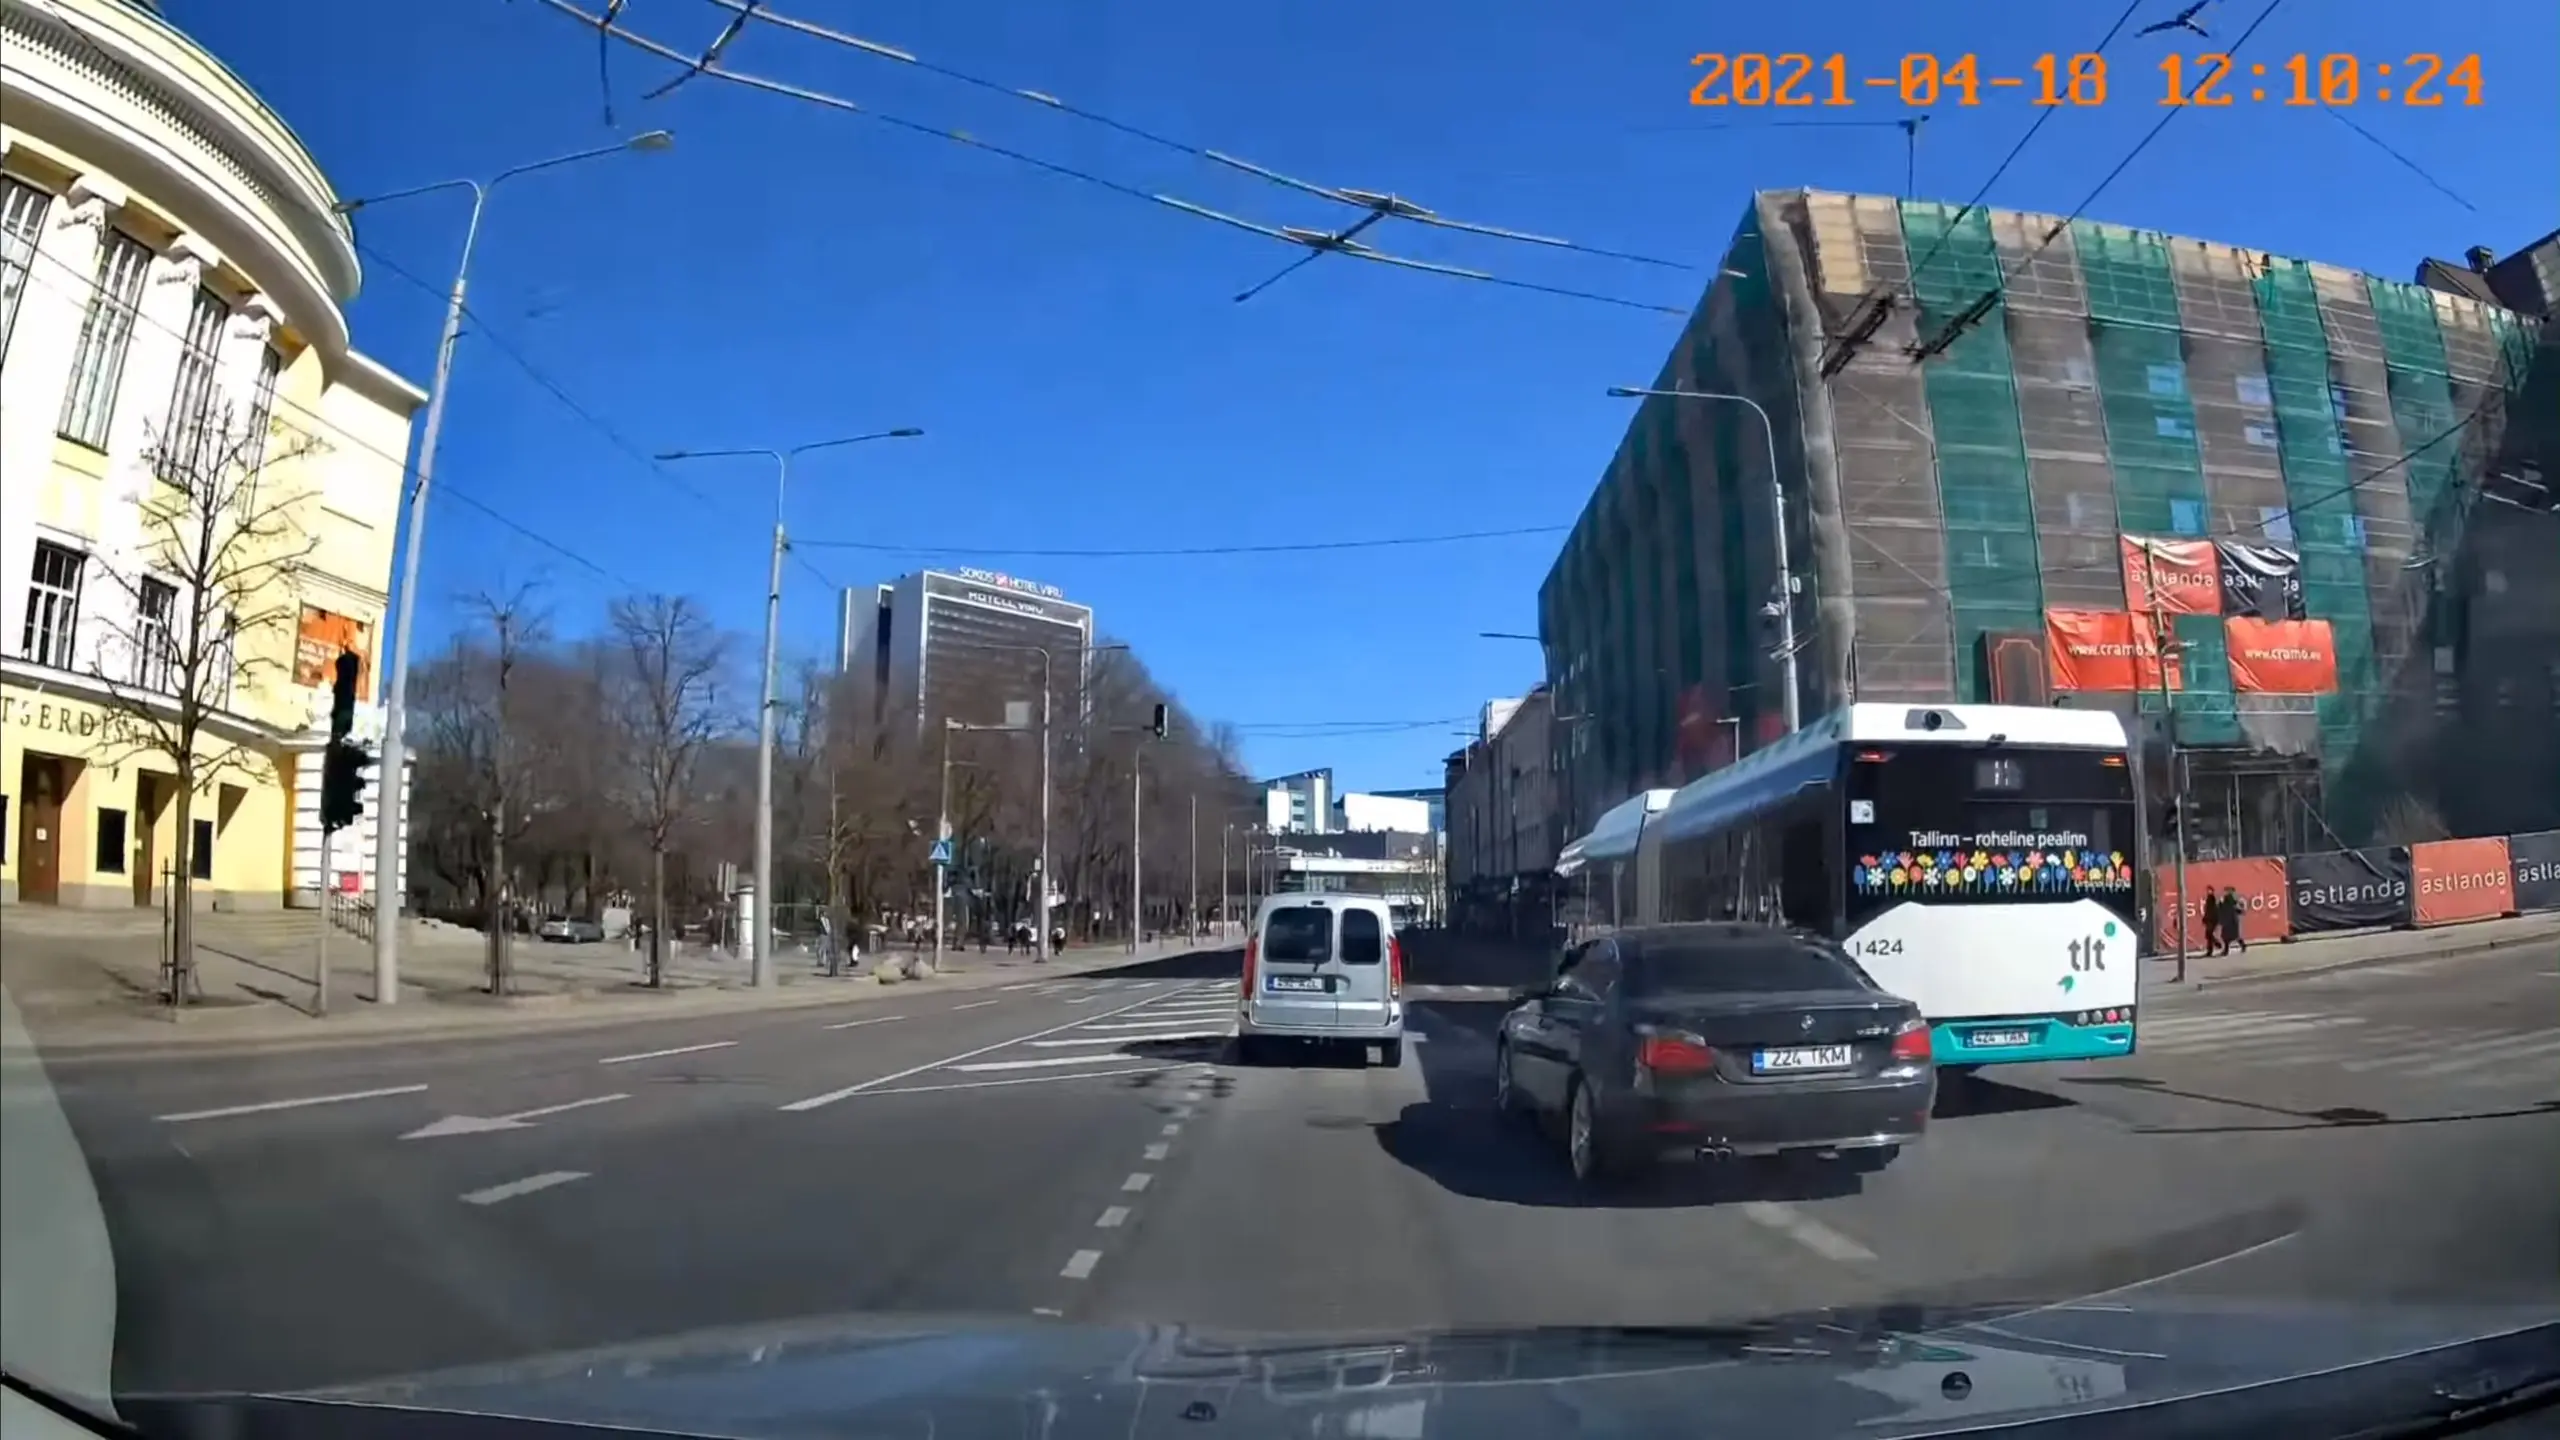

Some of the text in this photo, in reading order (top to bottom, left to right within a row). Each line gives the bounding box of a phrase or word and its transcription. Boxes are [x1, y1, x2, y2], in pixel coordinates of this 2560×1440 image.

[960, 565, 1063, 599] SOKOS HOTEL VIRU
[1909, 831, 1960, 847] Tallinn
[1976, 831, 2035, 847] roheline
[2037, 831, 2087, 848] pealinn
[2299, 877, 2406, 906] astlanda
[2421, 868, 2506, 895] astlanda
[2167, 892, 2280, 919] astnda
[2067, 935, 2105, 971] tlt
[1772, 1047, 1846, 1066] 224 TKM
